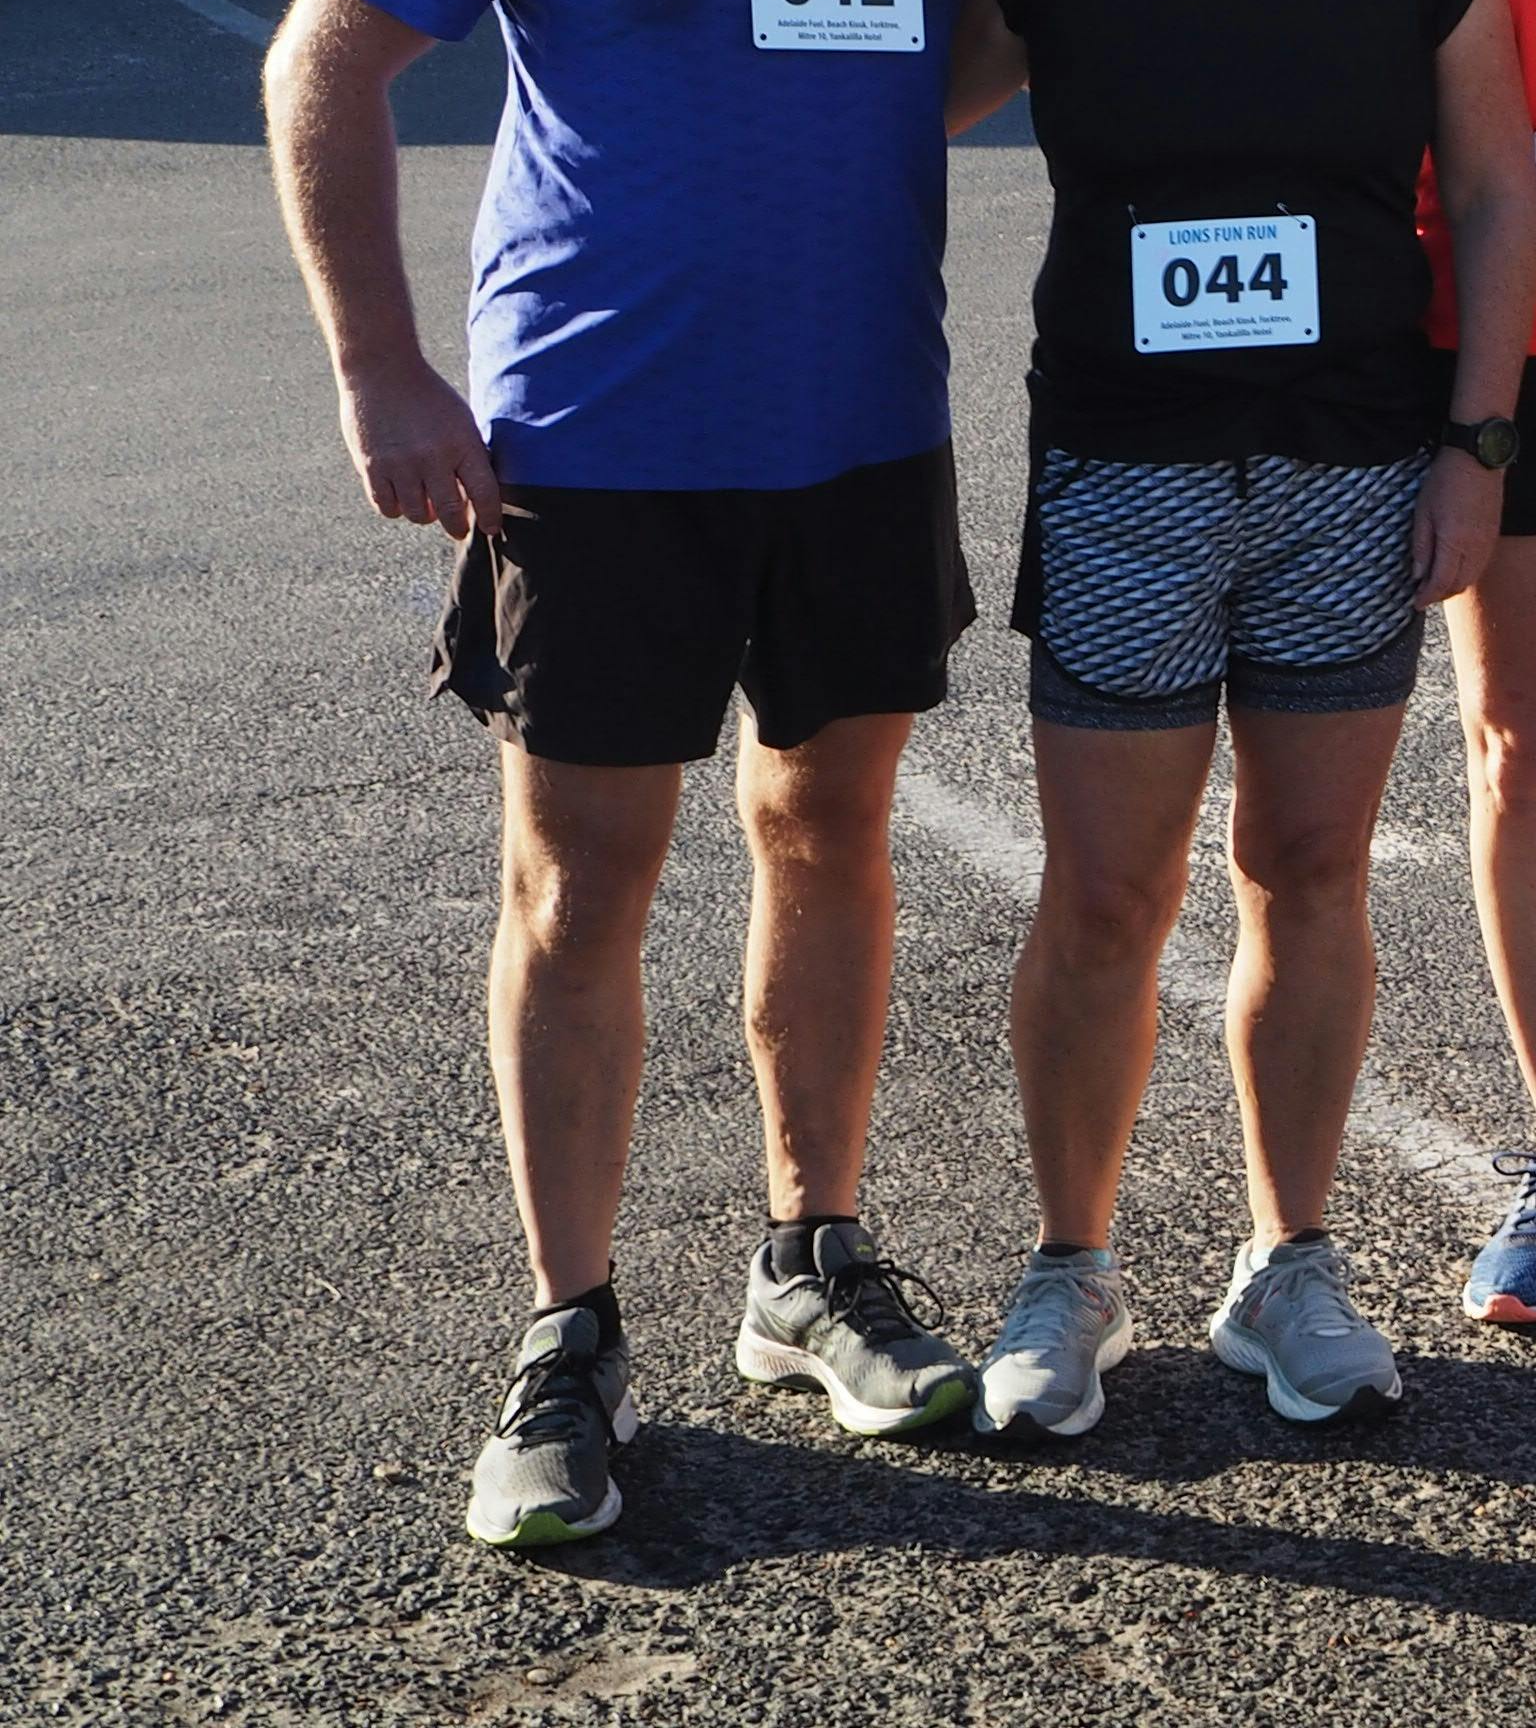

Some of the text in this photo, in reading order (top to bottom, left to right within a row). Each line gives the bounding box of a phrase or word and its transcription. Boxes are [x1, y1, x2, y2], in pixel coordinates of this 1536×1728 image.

[826, 19, 848, 29] Beach
[1168, 224, 1277, 246] LIONS FUN RUN
[1161, 252, 1289, 308] 044
